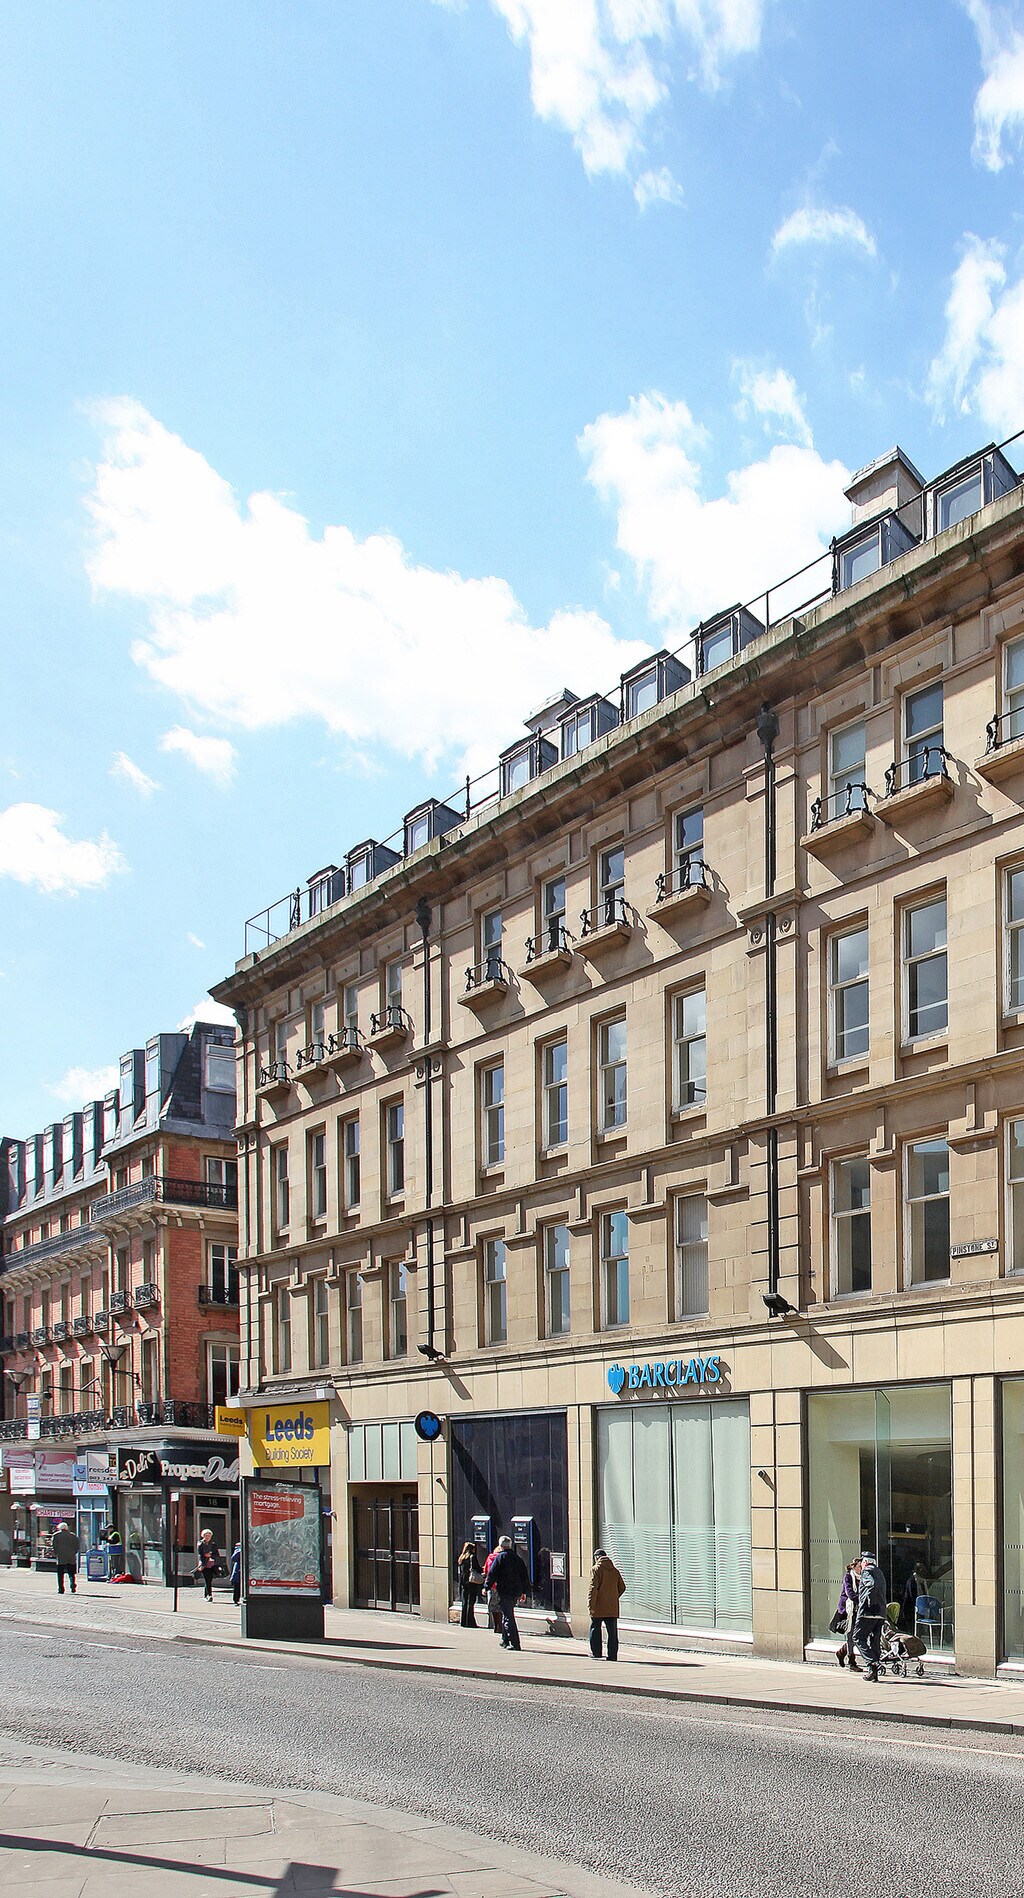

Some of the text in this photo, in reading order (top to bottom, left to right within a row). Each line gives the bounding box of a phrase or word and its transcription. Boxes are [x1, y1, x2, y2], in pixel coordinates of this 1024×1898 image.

[628, 1356, 720, 1388] BARCLAYS
[220, 1415, 243, 1424] Leeds
[265, 1411, 315, 1441] Leeds
[265, 1446, 315, 1463] Building Society
[125, 1453, 148, 1479] Deli
[263, 1494, 302, 1504] stress-relieving
